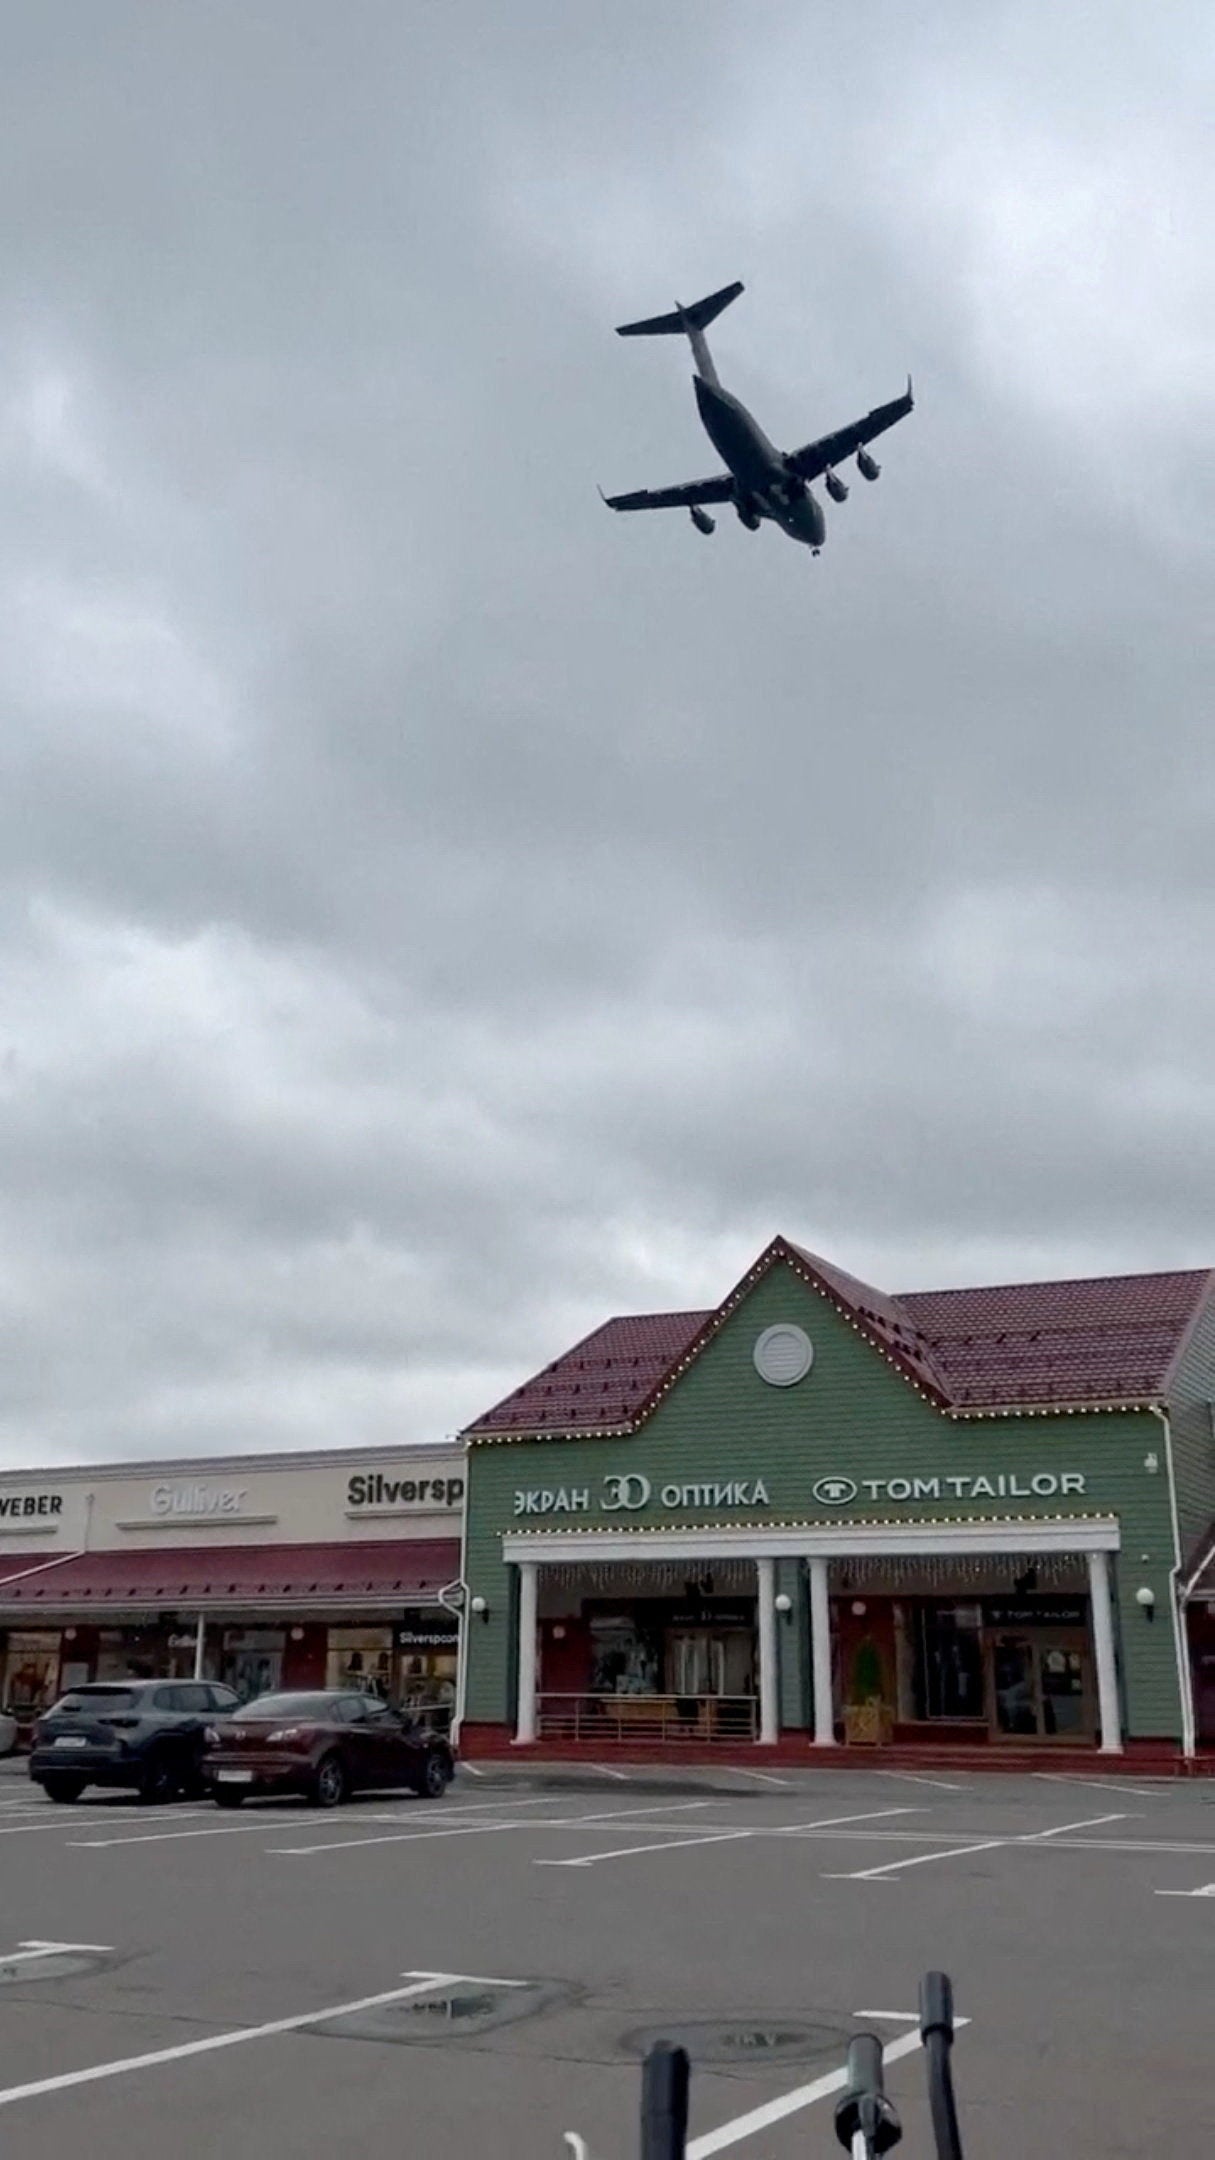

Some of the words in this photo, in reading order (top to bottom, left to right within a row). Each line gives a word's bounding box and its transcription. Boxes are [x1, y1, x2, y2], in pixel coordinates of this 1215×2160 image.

[151, 1485, 249, 1514] Gulliver
[514, 1487, 590, 1515] ЭКРАН
[661, 1479, 770, 1508] ОПТИКА
[861, 1478, 940, 1500] TOM
[946, 1473, 1087, 1498] TAILOR
